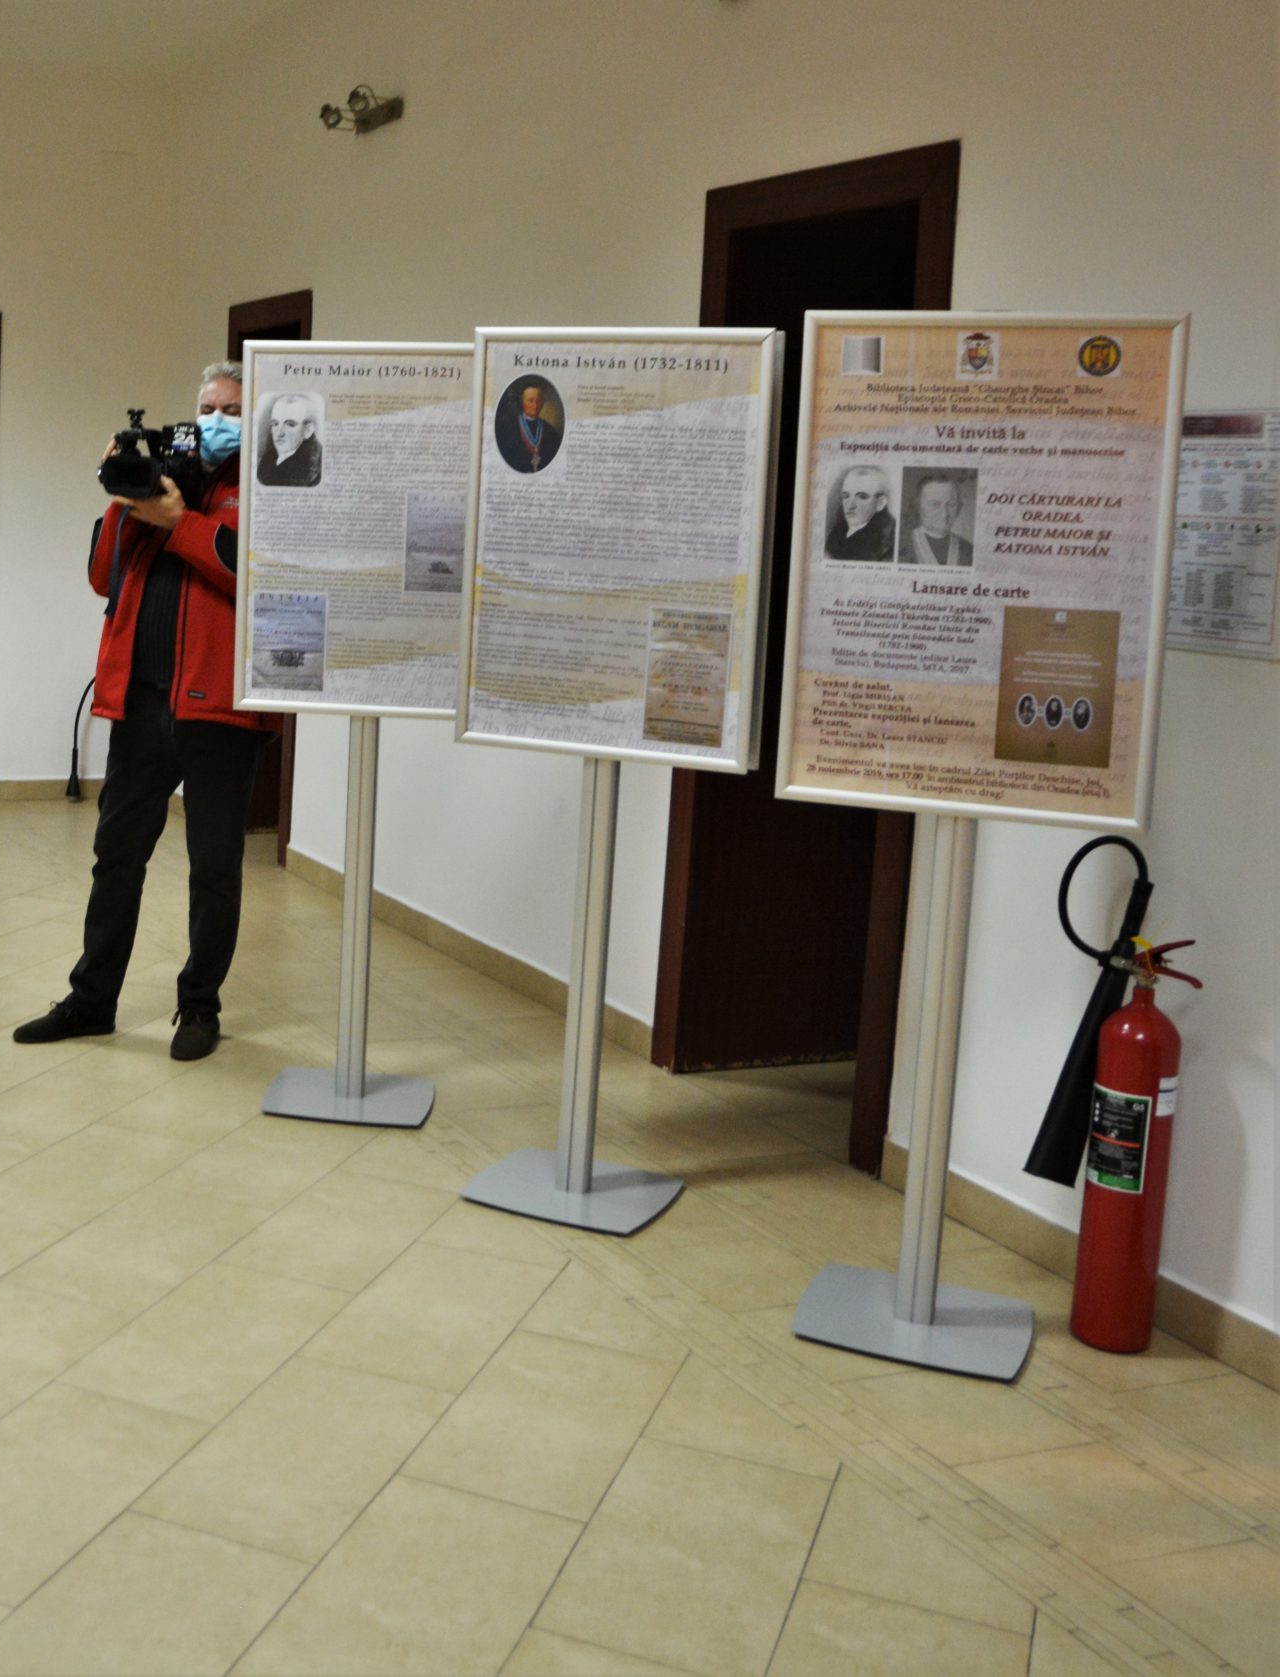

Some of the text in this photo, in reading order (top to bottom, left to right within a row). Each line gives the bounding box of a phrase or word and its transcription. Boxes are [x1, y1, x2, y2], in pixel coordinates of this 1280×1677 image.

[513, 354, 729, 374] Katona István (1732-1811)
[284, 364, 462, 380] Petru Maior (1760-1821)
[866, 383, 916, 393] Biblioteca
[1029, 395, 1069, 404] Oradea
[932, 404, 946, 413] ale
[172, 432, 196, 446] 24
[936, 425, 1026, 440] Vă invită la
[966, 443, 979, 453] de
[982, 444, 1008, 454] carte
[1012, 445, 1044, 455] veche
[1060, 448, 1125, 457] manuscrise
[987, 493, 1015, 505] DOI
[1103, 497, 1123, 508] LA
[994, 526, 1042, 538] PETRU
[1043, 527, 1096, 540] MAIOR
[993, 542, 1053, 556] KATONA
[912, 580, 1030, 599] Lansare de carte
[832, 618, 861, 628] Istoria
[939, 623, 963, 633] Unite
[965, 625, 980, 634] din
[891, 632, 910, 642] prin
[858, 649, 868, 658] de
[870, 650, 918, 661] documente
[951, 654, 977, 665] Laura
[851, 680, 864, 690] de
[812, 707, 869, 719] Prezentarea
[934, 716, 975, 727] lansarea
[812, 717, 824, 727] de
[940, 764, 970, 775] cadrul
